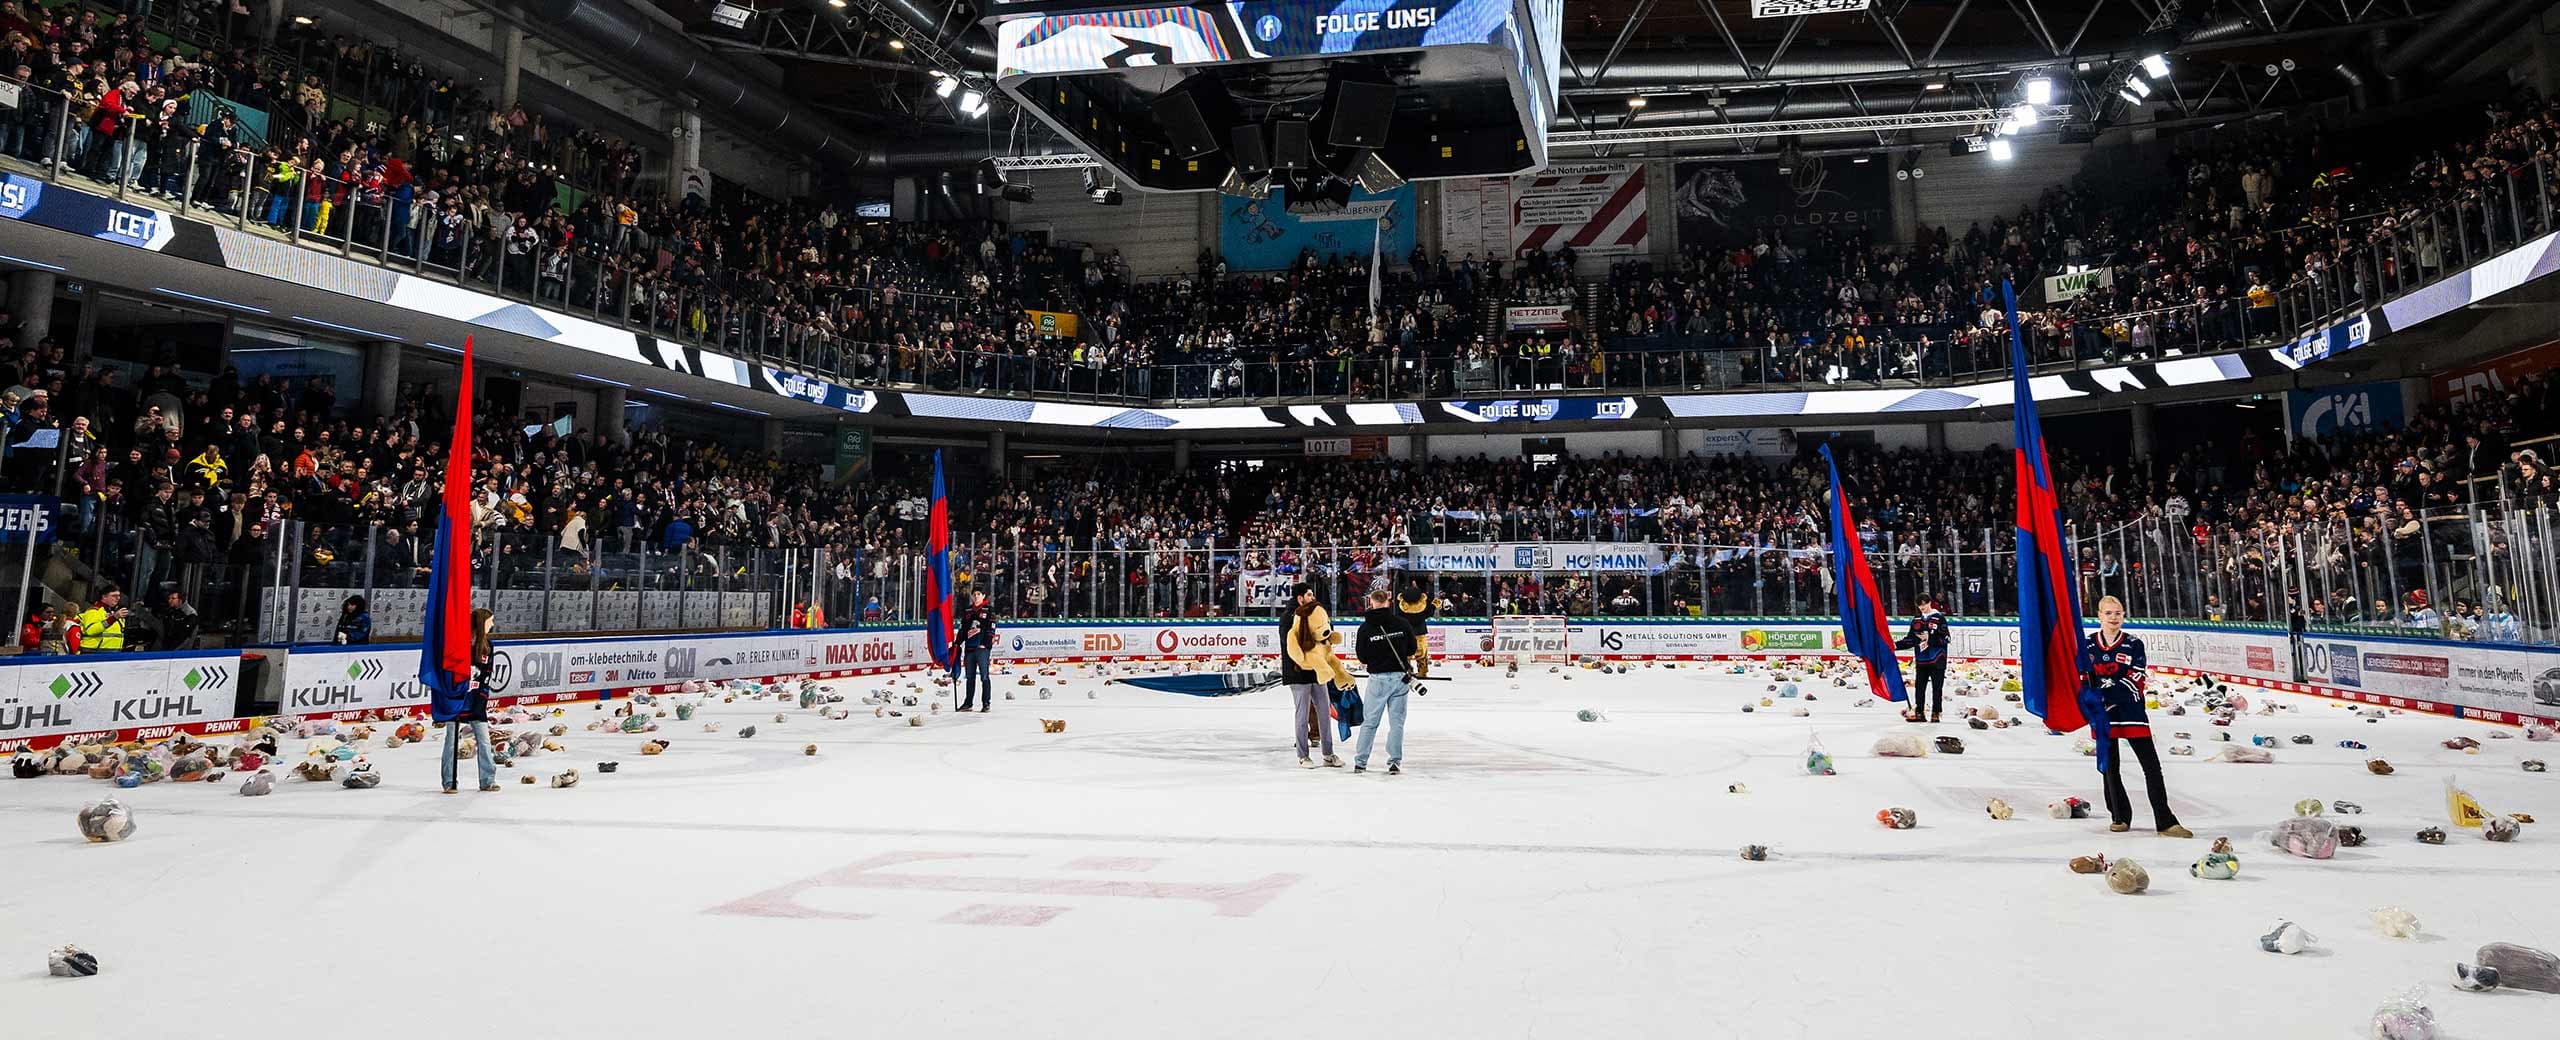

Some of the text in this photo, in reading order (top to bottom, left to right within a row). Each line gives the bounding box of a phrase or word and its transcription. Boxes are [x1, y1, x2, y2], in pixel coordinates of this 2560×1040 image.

[1315, 9, 1436, 35] FOLGE UNS!
[1558, 165, 1606, 176] Notrufsäule
[1608, 163, 1625, 172] hilft
[783, 377, 806, 396] FOLGE
[807, 384, 824, 399] UNS!
[1479, 404, 1518, 418] FOLGE
[1522, 403, 1552, 417] UNS!
[1968, 582, 1981, 593] 47
[1024, 638, 1077, 647] Deutsche Krebshilfe
[1083, 634, 1122, 650] EMS
[1182, 634, 1247, 647] vodafone
[1498, 636, 1564, 650] Tucher
[1658, 632, 1703, 640] SOLUTIONS
[736, 648, 800, 665] DR. ERLER KLINIKEN
[825, 637, 896, 665] MAX BÖGL
[571, 650, 658, 667] om-klebetechnik.de
[605, 670, 619, 682] 3M
[627, 668, 656, 681] Nitto
[2457, 664, 2477, 678] Immer
[2484, 667, 2496, 680] den
[2496, 667, 2526, 684] Playoffs.
[291, 680, 363, 707] KÜHL
[517, 695, 540, 706] PENNY.
[556, 692, 578, 702] PENNY.
[112, 689, 202, 722] KÜHL
[2417, 701, 2434, 712] PENNY.
[2463, 707, 2503, 721] PENNY. PENNY.
[205, 721, 241, 733] PENNY.
